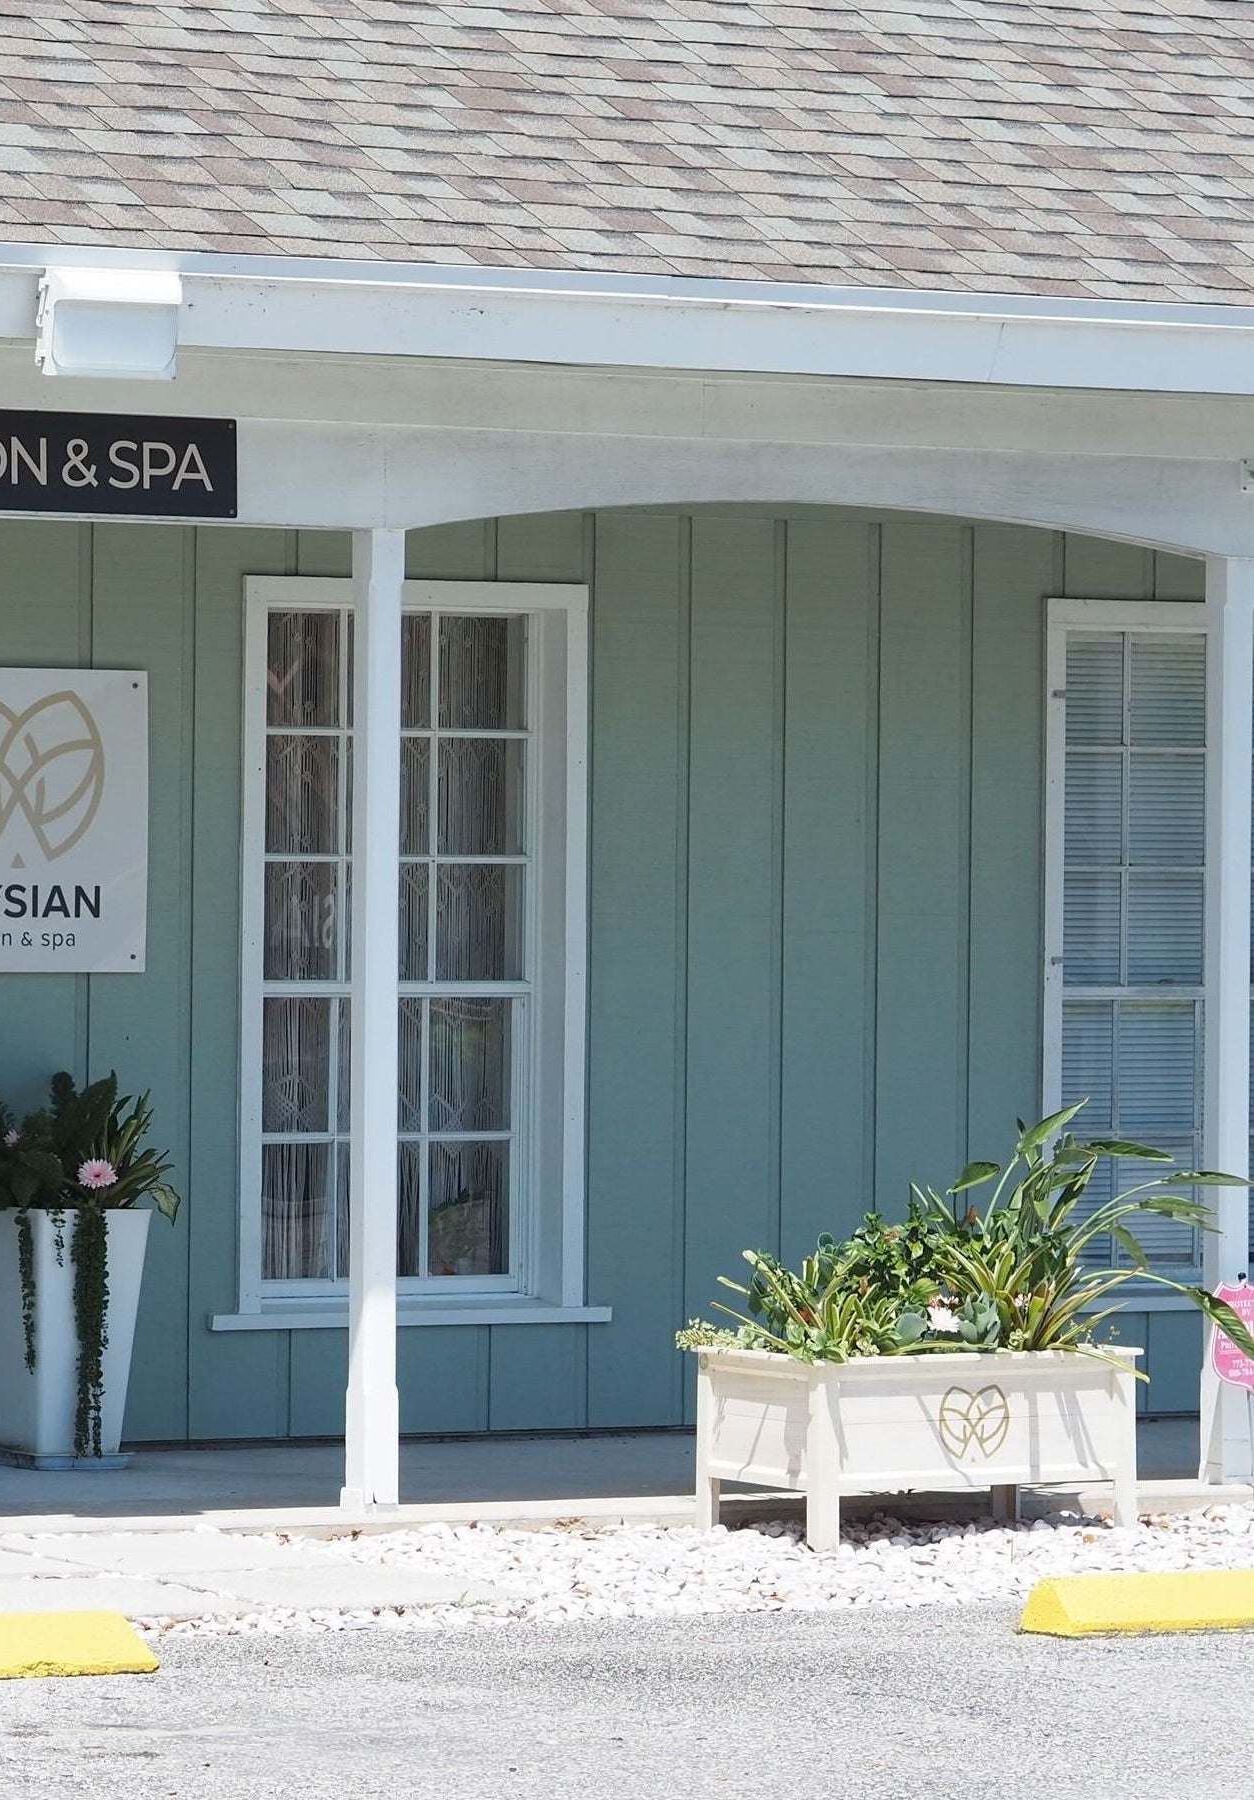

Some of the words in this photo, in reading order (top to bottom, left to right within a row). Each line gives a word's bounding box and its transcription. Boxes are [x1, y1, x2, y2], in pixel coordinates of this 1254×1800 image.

[61, 437, 99, 488] &
[108, 440, 215, 492] SPA
[20, 931, 33, 947] &
[41, 932, 76, 951] spa
